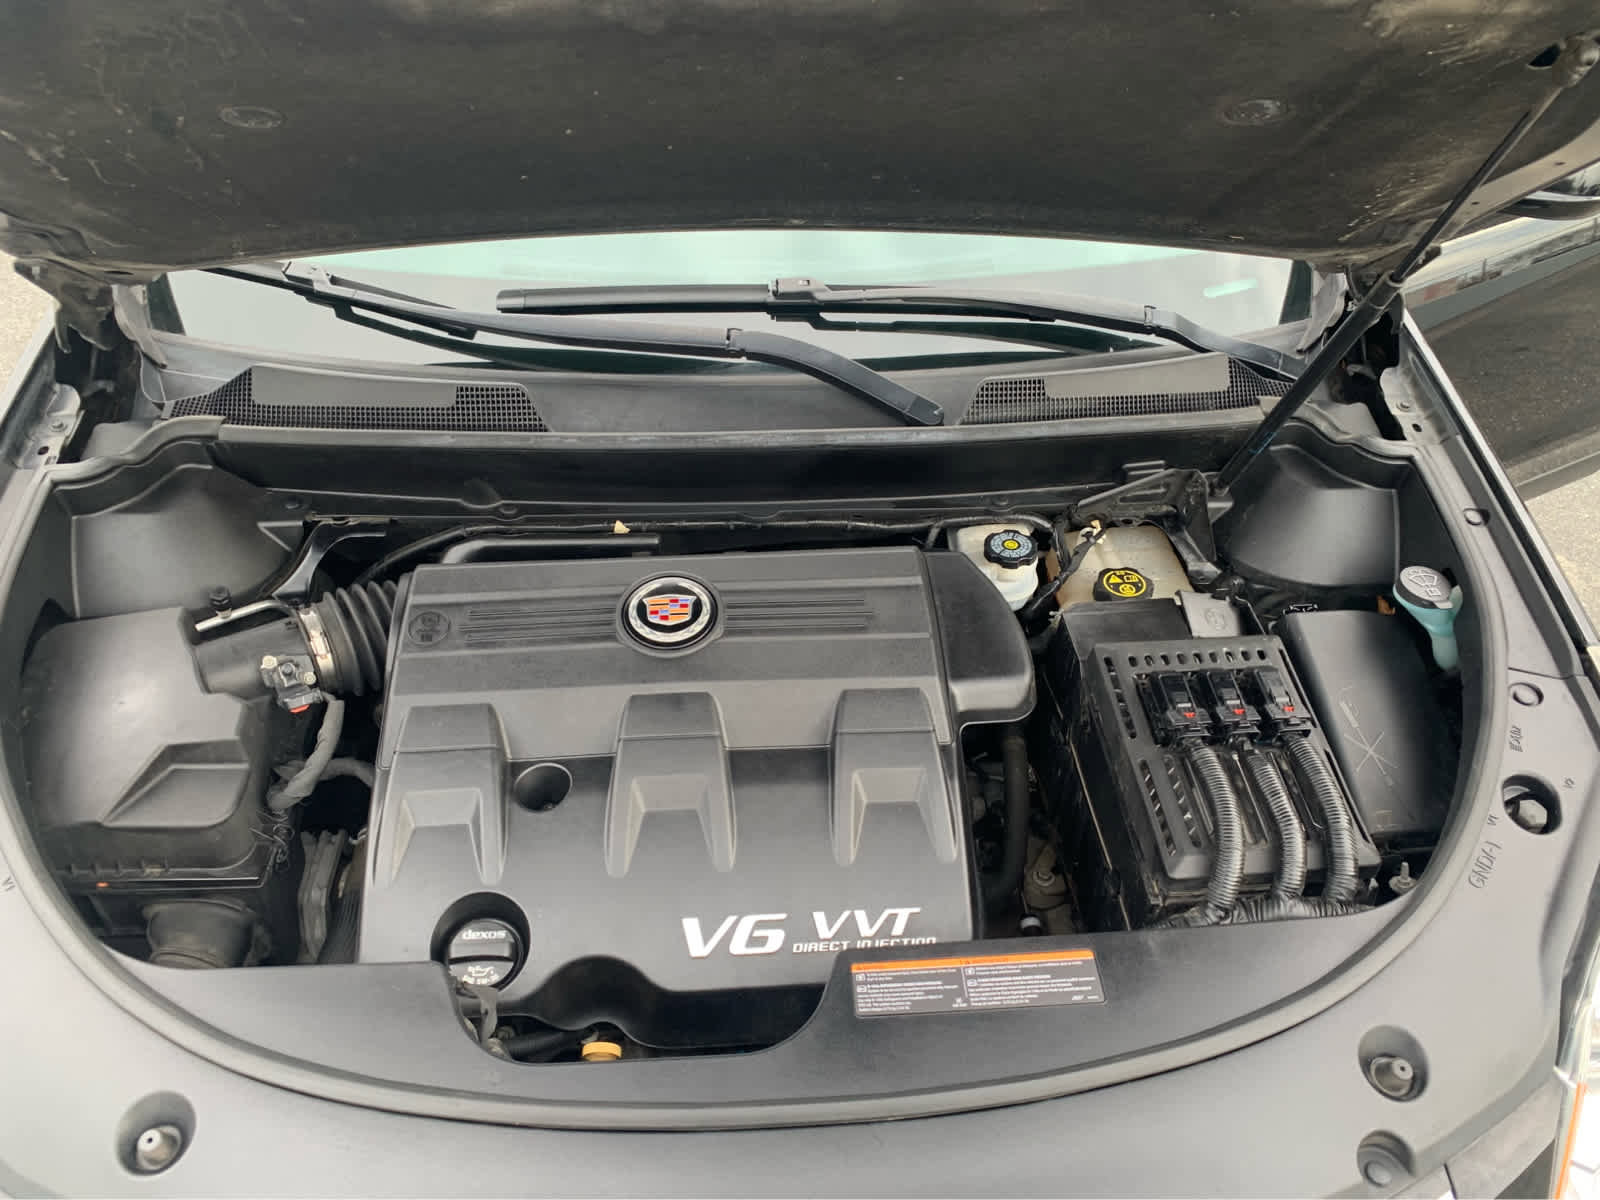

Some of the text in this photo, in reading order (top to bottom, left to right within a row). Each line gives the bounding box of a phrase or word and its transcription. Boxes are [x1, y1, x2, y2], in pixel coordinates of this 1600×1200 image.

[461, 929, 507, 940] dexos
[681, 906, 921, 958] V6 VVT
[792, 940, 851, 953] DIRECT
